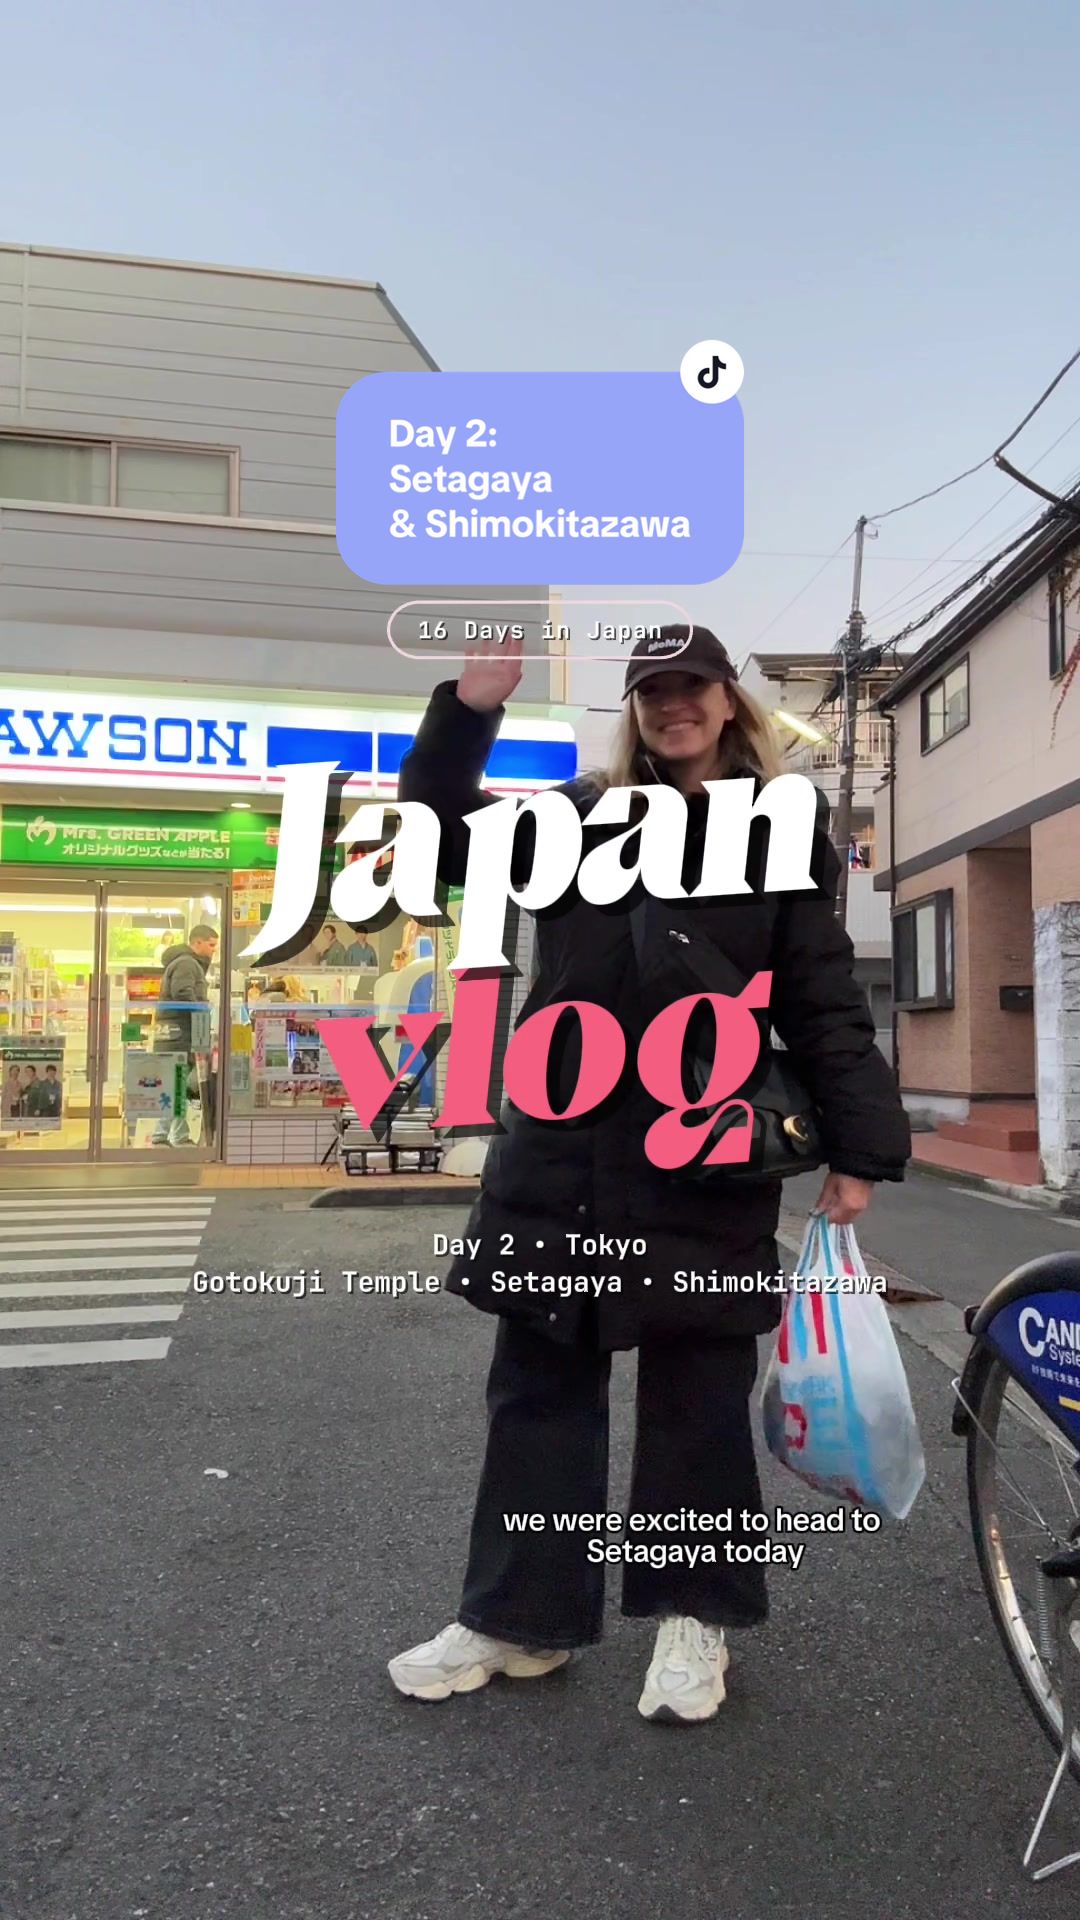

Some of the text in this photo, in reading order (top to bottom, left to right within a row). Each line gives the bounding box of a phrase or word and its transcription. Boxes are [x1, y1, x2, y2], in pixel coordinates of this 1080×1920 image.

[647, 638, 685, 653] MoMA
[63, 828, 231, 843] Mrs. GREEN APPLE
